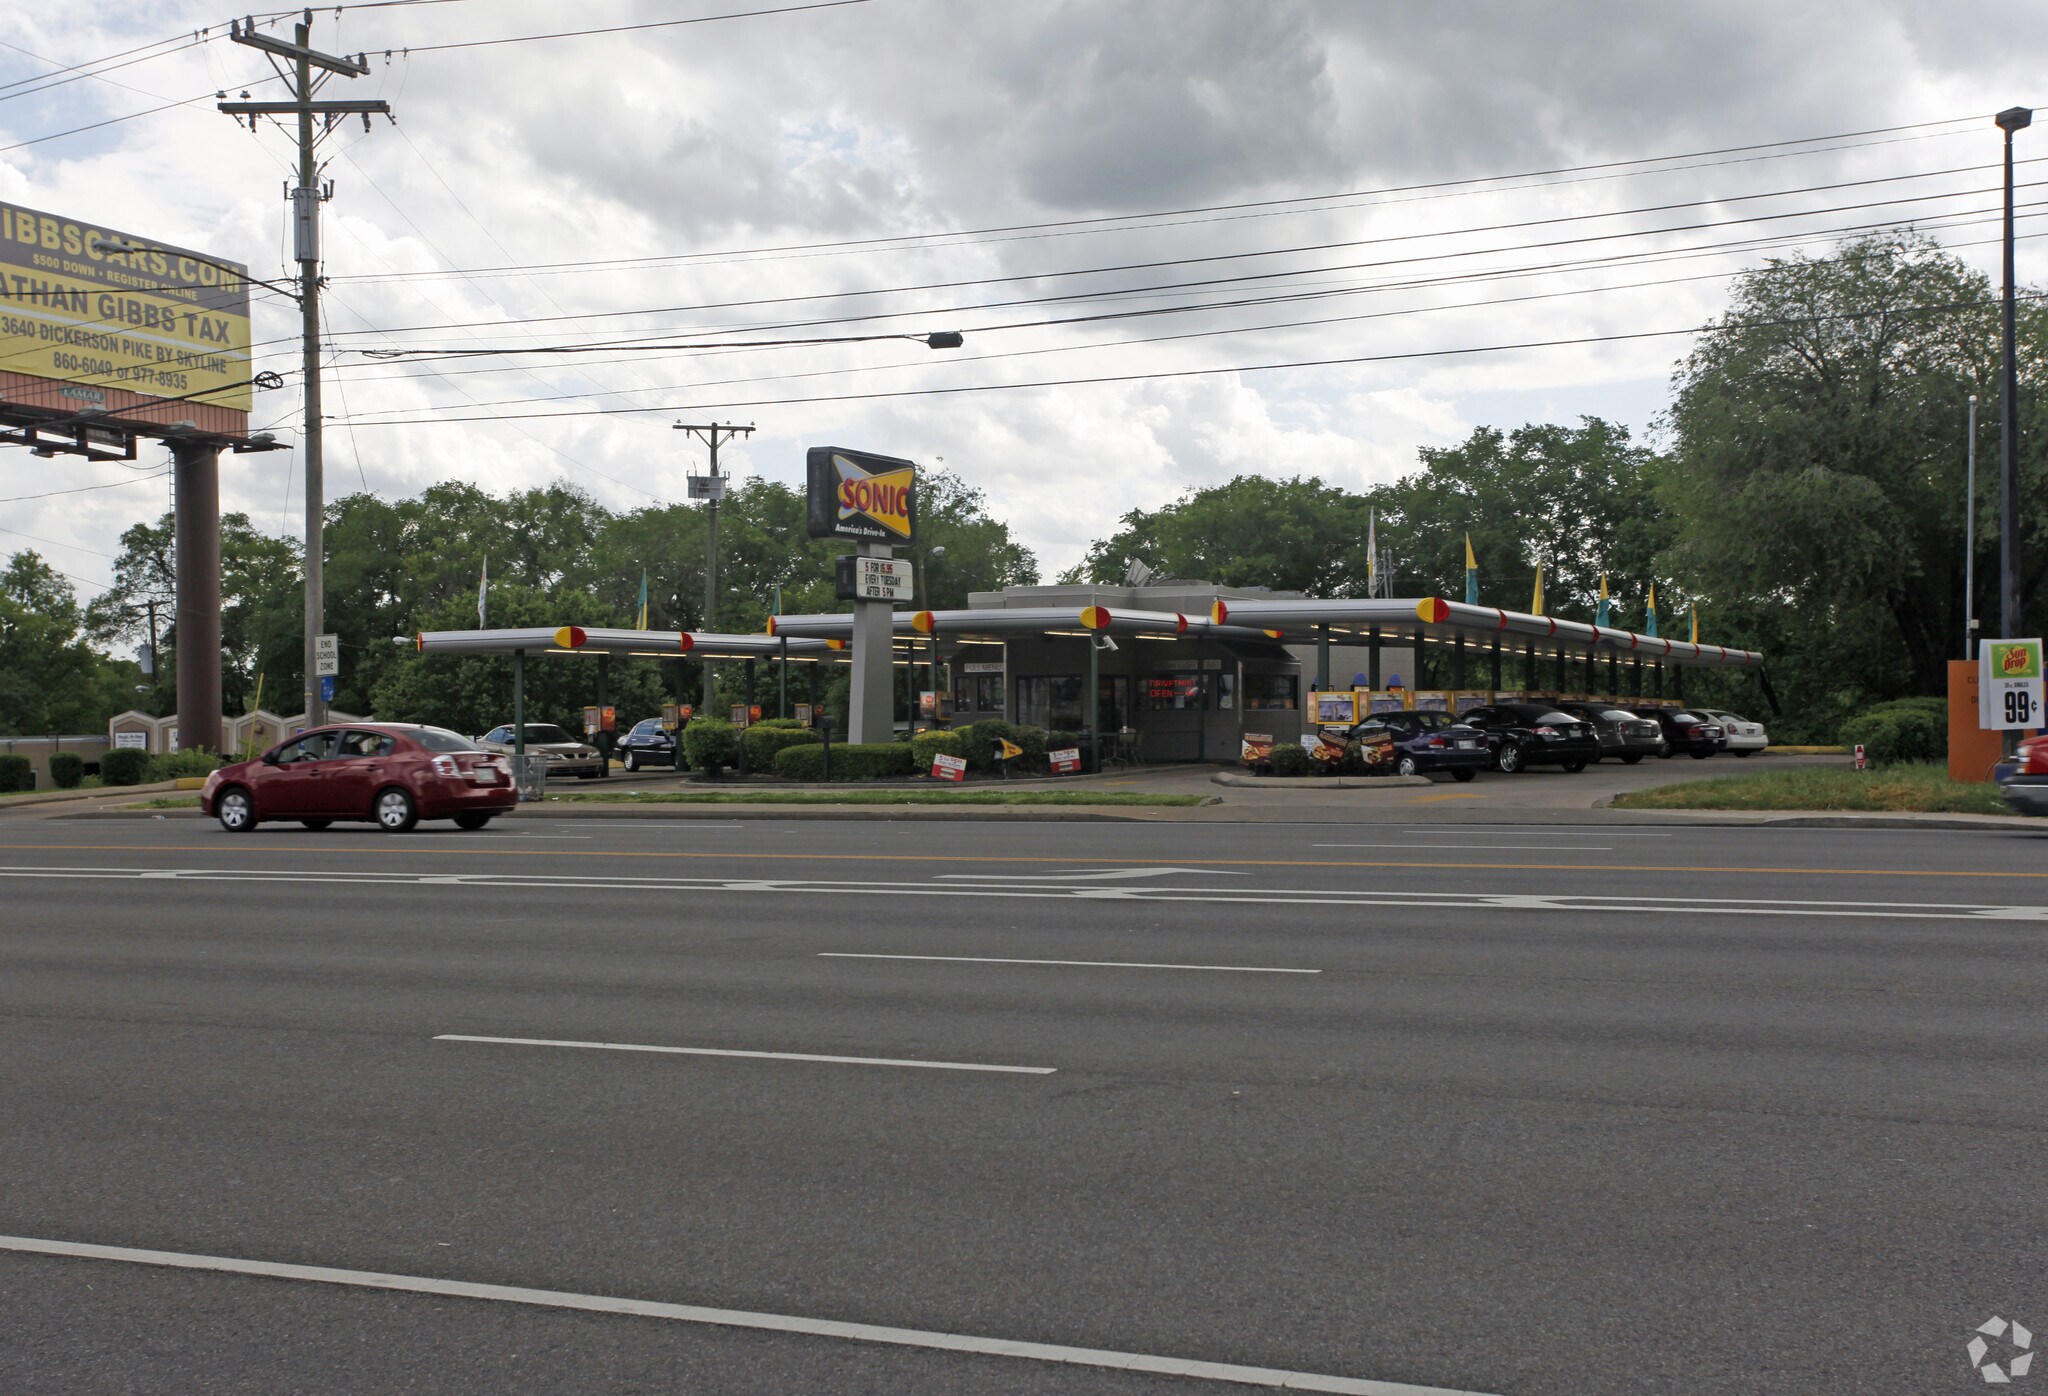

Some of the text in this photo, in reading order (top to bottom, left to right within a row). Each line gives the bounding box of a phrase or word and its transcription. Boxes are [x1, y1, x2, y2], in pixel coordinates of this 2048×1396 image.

[63, 260, 95, 277] DOWN
[107, 270, 158, 290] REGISTER
[161, 283, 198, 301] ONLINE
[98, 293, 175, 332] GIBBS
[183, 312, 231, 344] TAX
[2, 316, 227, 374] 3640 DICKERSON PIKE BY SKYLINE
[54, 352, 112, 377] 860-6049
[133, 366, 188, 390] 977-8935
[64, 388, 101, 400] LAMAR
[841, 477, 909, 518] SONIC
[835, 523, 886, 537] America's Drive-In
[865, 561, 869, 572] 5
[871, 562, 879, 573] FOR
[881, 575, 901, 586] TUESDAY
[866, 586, 880, 596] AFTER
[886, 588, 894, 597] PM
[321, 640, 332, 649] END
[316, 651, 337, 660] SCHOOL
[2006, 647, 2027, 661] Sun
[320, 662, 334, 670] ZONE
[2004, 657, 2026, 671] Drop
[1151, 689, 1174, 698] OPEN
